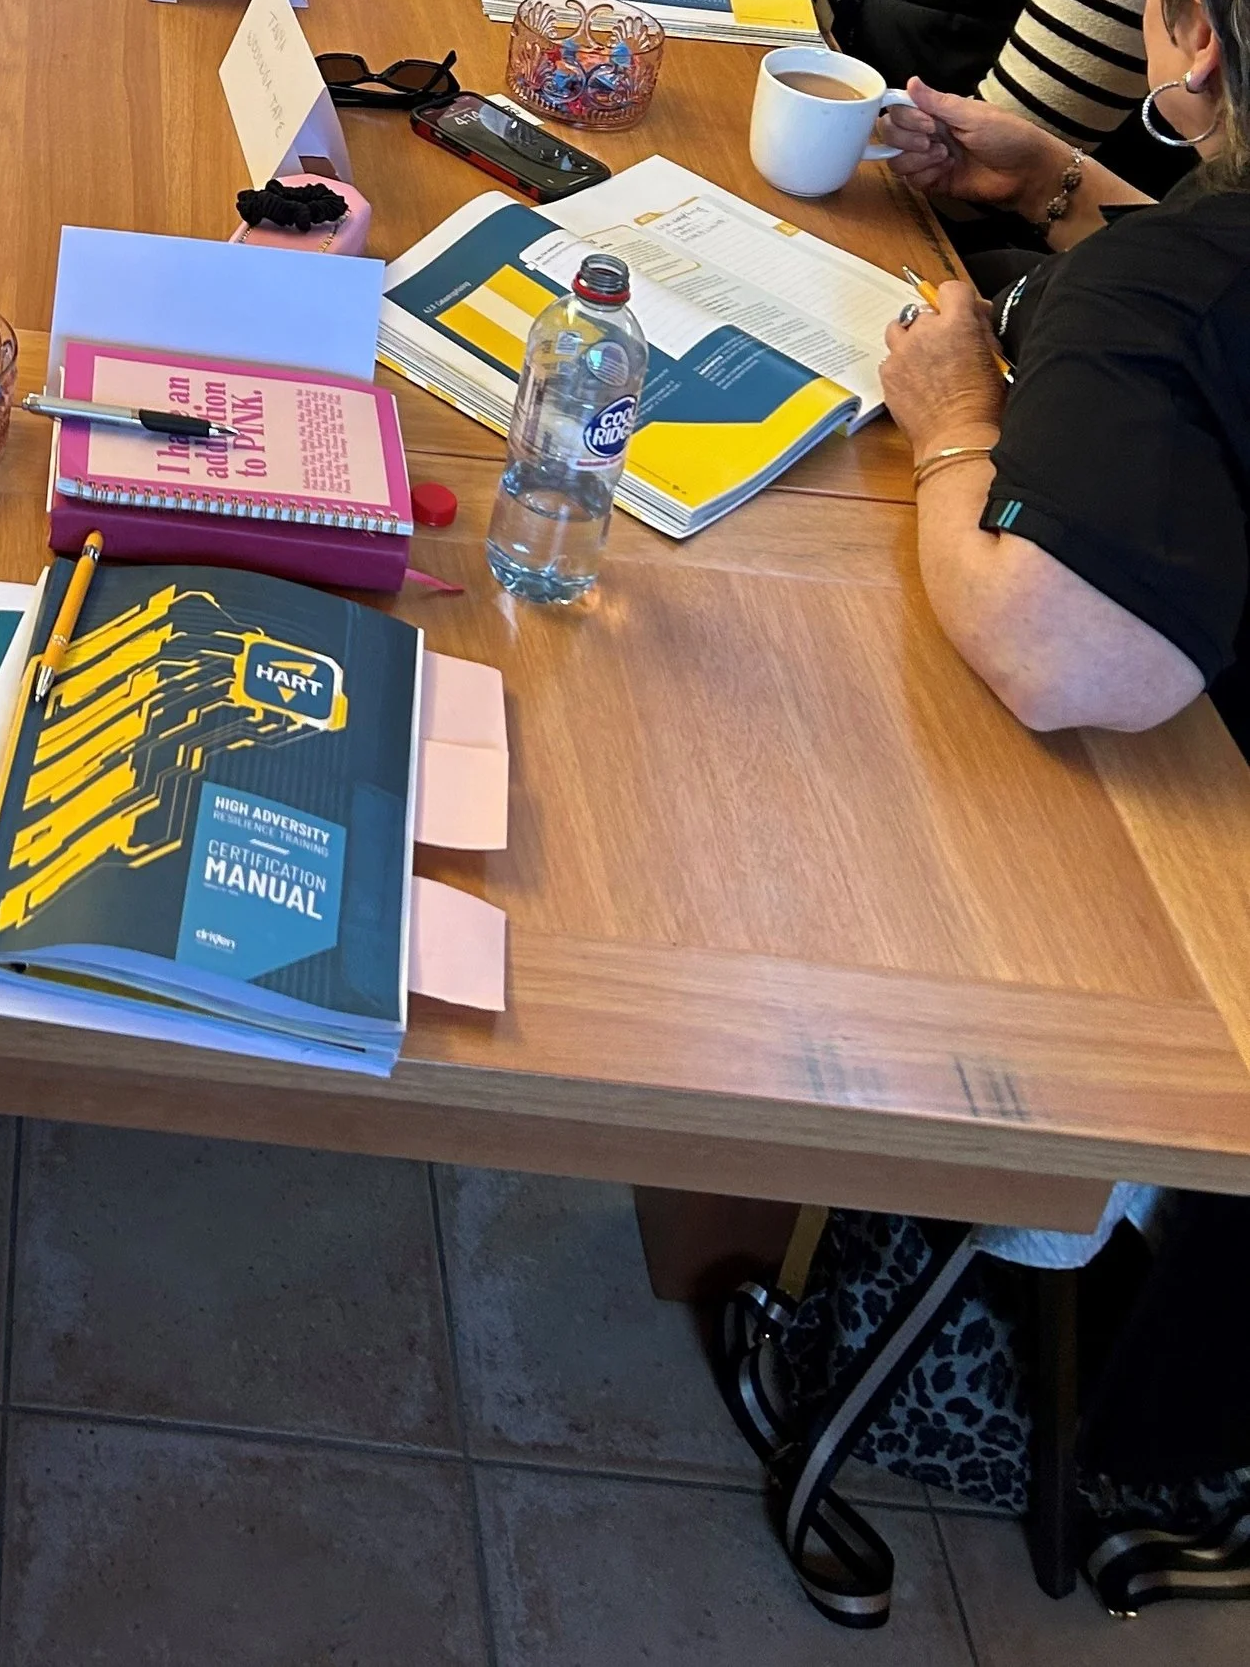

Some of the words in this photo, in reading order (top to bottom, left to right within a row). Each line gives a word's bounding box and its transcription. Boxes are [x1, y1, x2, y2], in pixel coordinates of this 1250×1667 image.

[169, 376, 191, 404] an
[157, 409, 191, 460] hae
[157, 464, 191, 474] I
[236, 458, 268, 478] to
[255, 663, 323, 696] HART
[213, 811, 274, 838] RESILIENCE
[279, 829, 329, 858] TRAINING
[215, 796, 248, 817] HIGH
[252, 807, 330, 845] ADVERSITY
[204, 856, 323, 921] MANUAL
[208, 839, 326, 893] CERTIFICATION
